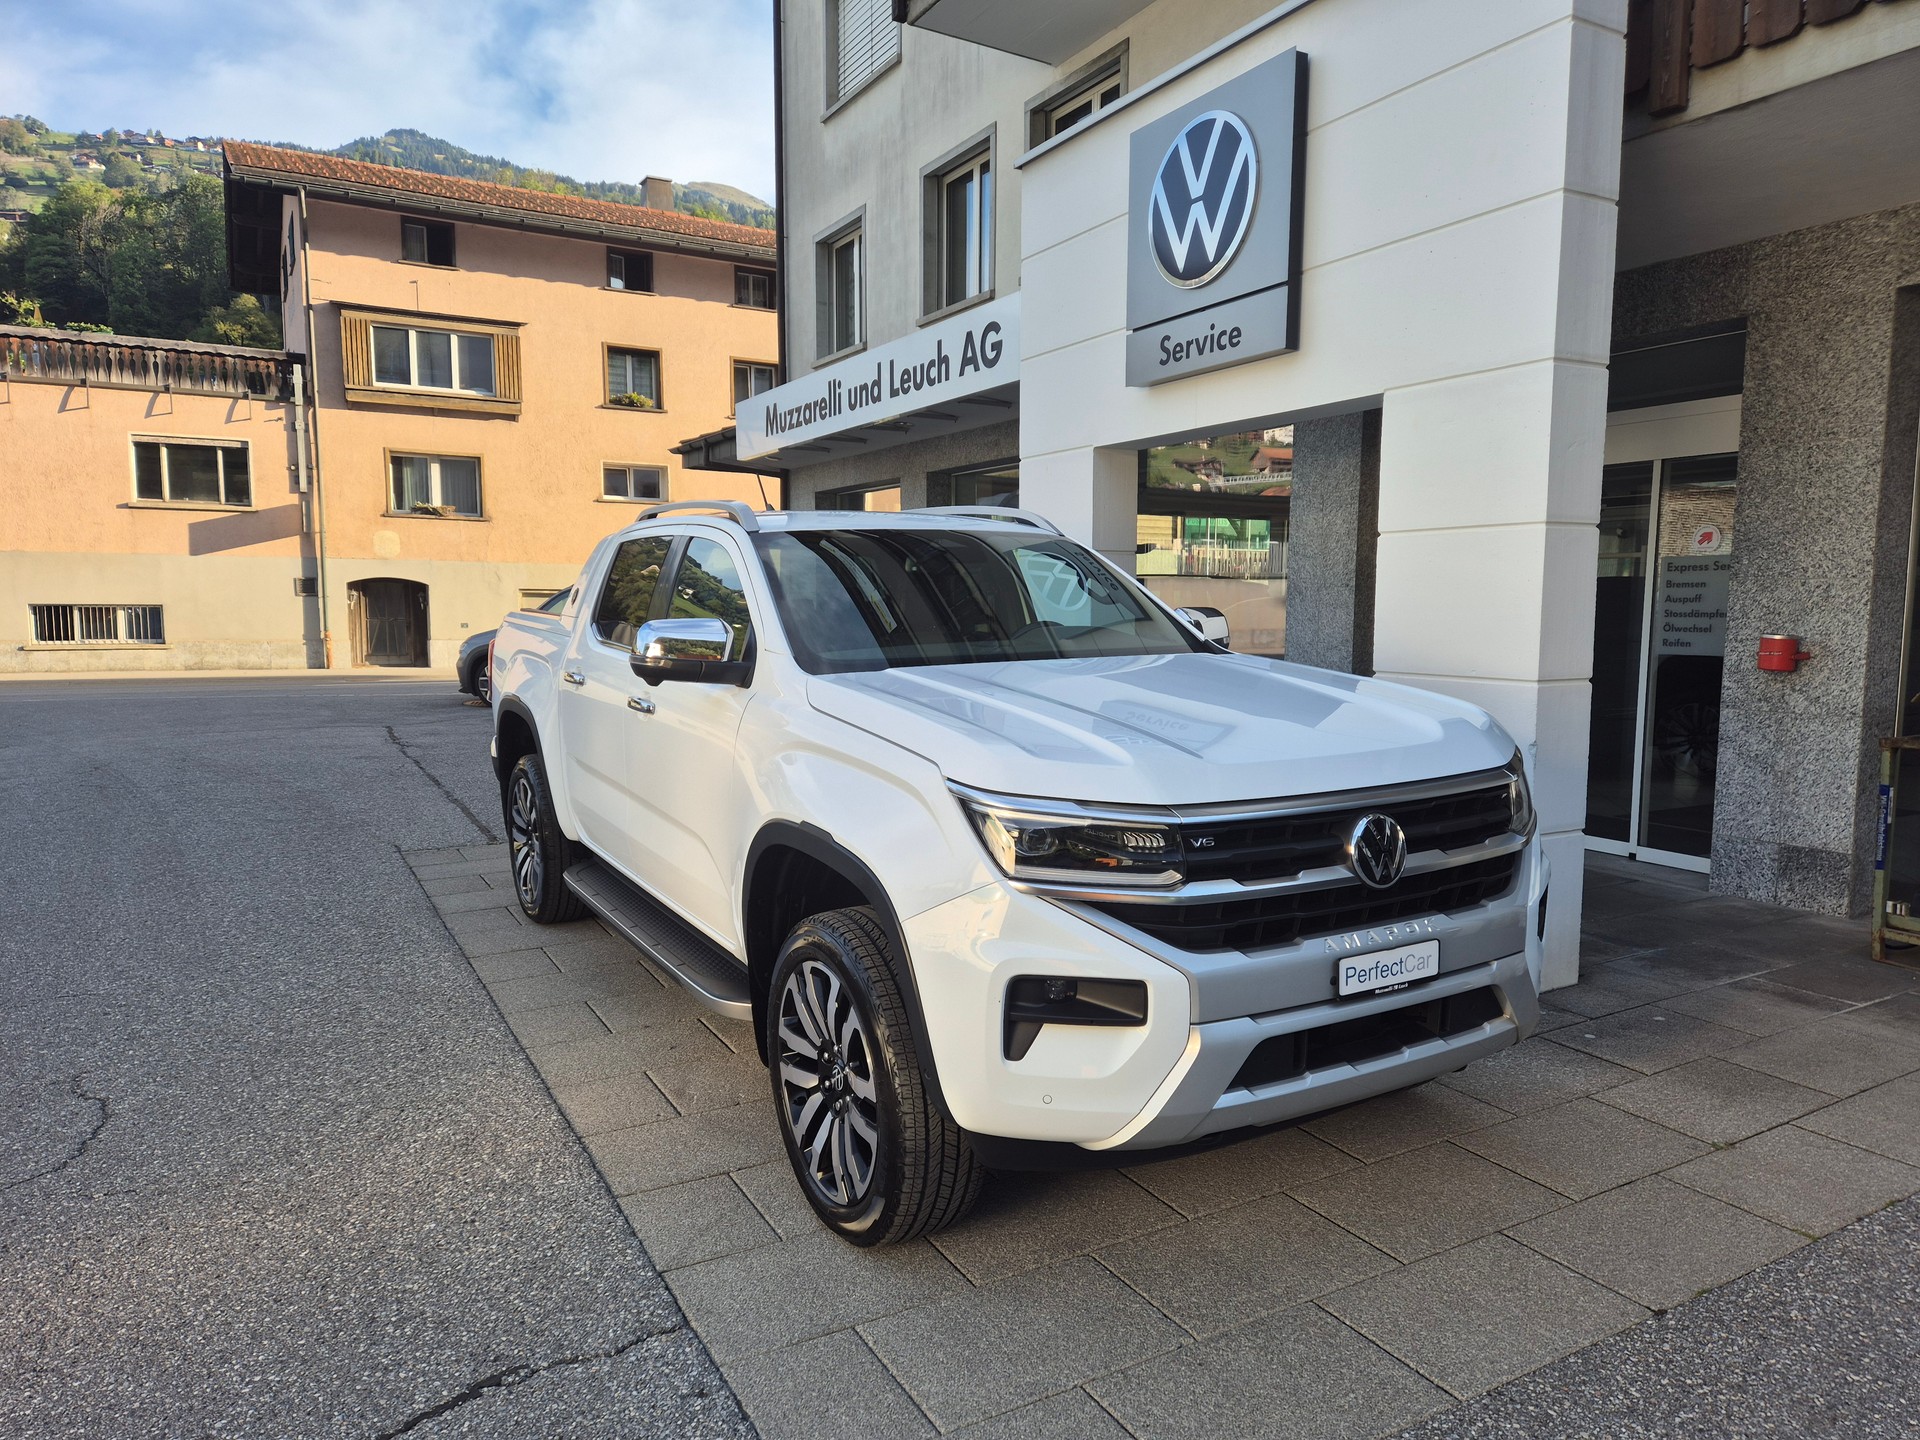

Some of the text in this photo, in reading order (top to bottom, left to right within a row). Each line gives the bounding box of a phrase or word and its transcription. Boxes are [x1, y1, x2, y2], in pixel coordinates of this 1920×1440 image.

[1149, 110, 1257, 288] VW
[1158, 323, 1243, 366] Service
[765, 320, 1004, 438] Muzzarelli und Leuch AG
[1666, 562, 1710, 574] Express
[1665, 579, 1707, 589] Bremsen
[1664, 594, 1703, 605] Auspuff
[1662, 622, 1713, 633] Ölwechsel
[1662, 638, 1692, 648] Reifen
[1190, 837, 1216, 849] V6
[1350, 812, 1407, 889] VW
[1324, 918, 1440, 953] AMAROK
[1345, 954, 1432, 987] PerfectCar
